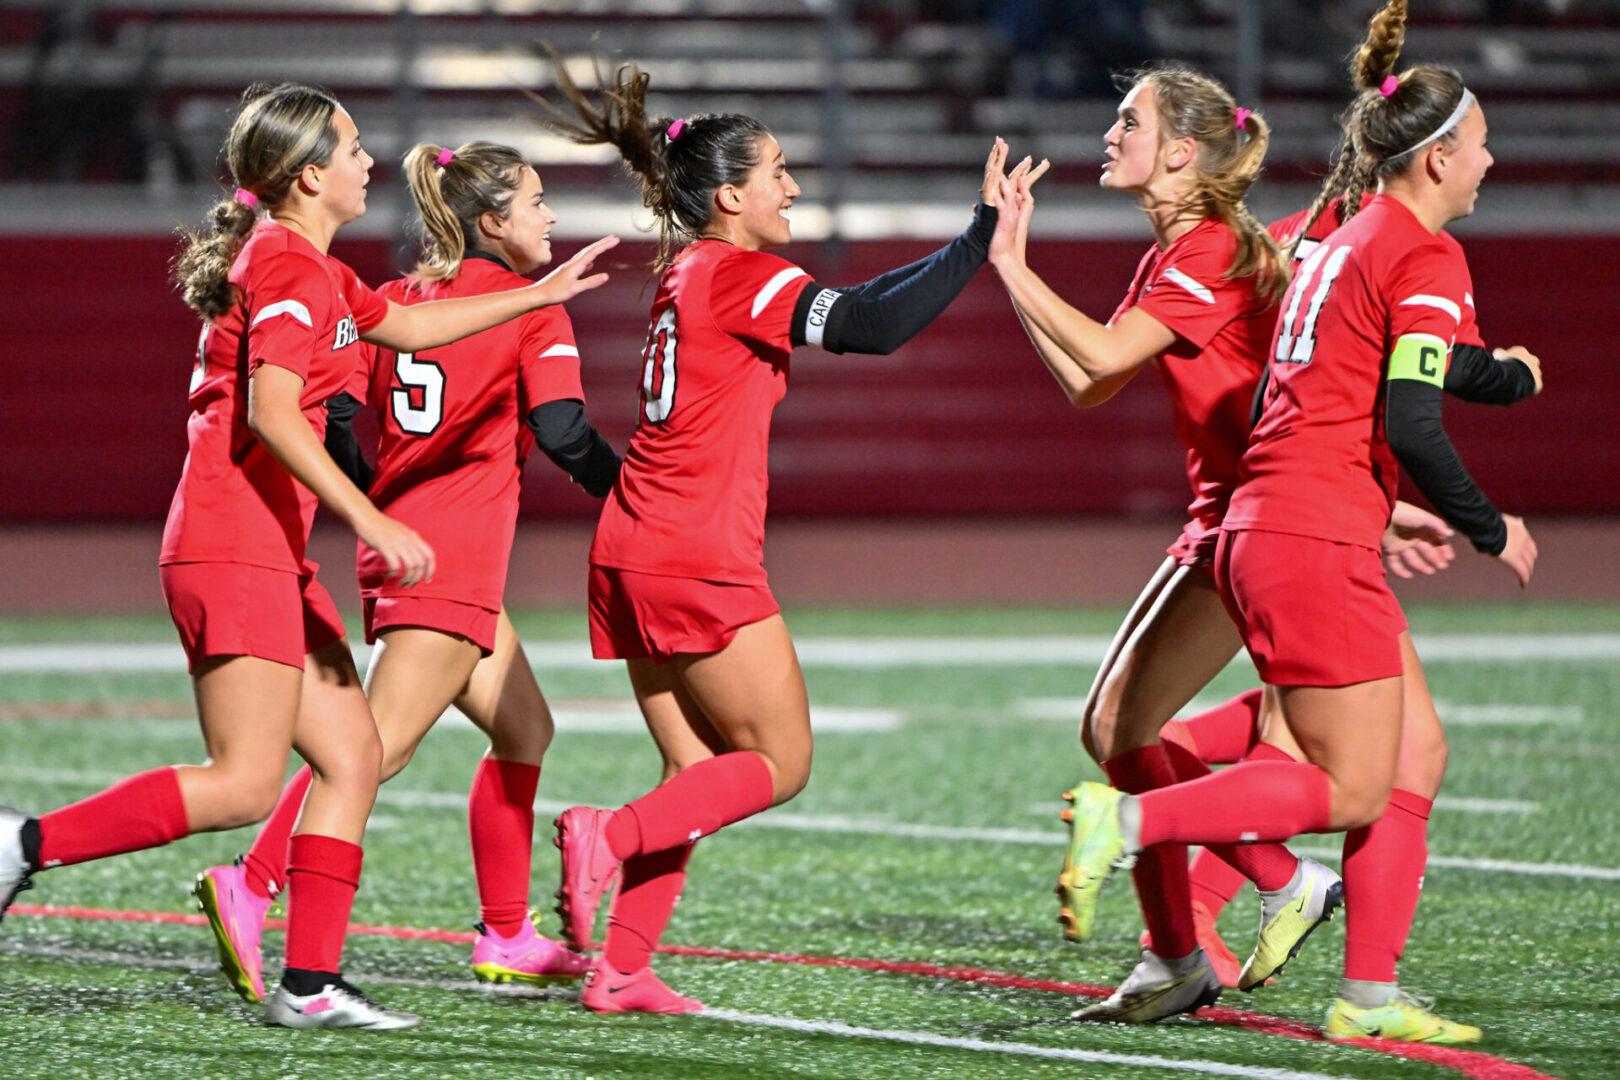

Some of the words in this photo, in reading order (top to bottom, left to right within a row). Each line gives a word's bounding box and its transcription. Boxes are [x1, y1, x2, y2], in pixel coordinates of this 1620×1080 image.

[1275, 245, 1352, 364] 11
[391, 351, 446, 436] 5
[641, 307, 677, 425] 0
[1419, 346, 1438, 377] C
